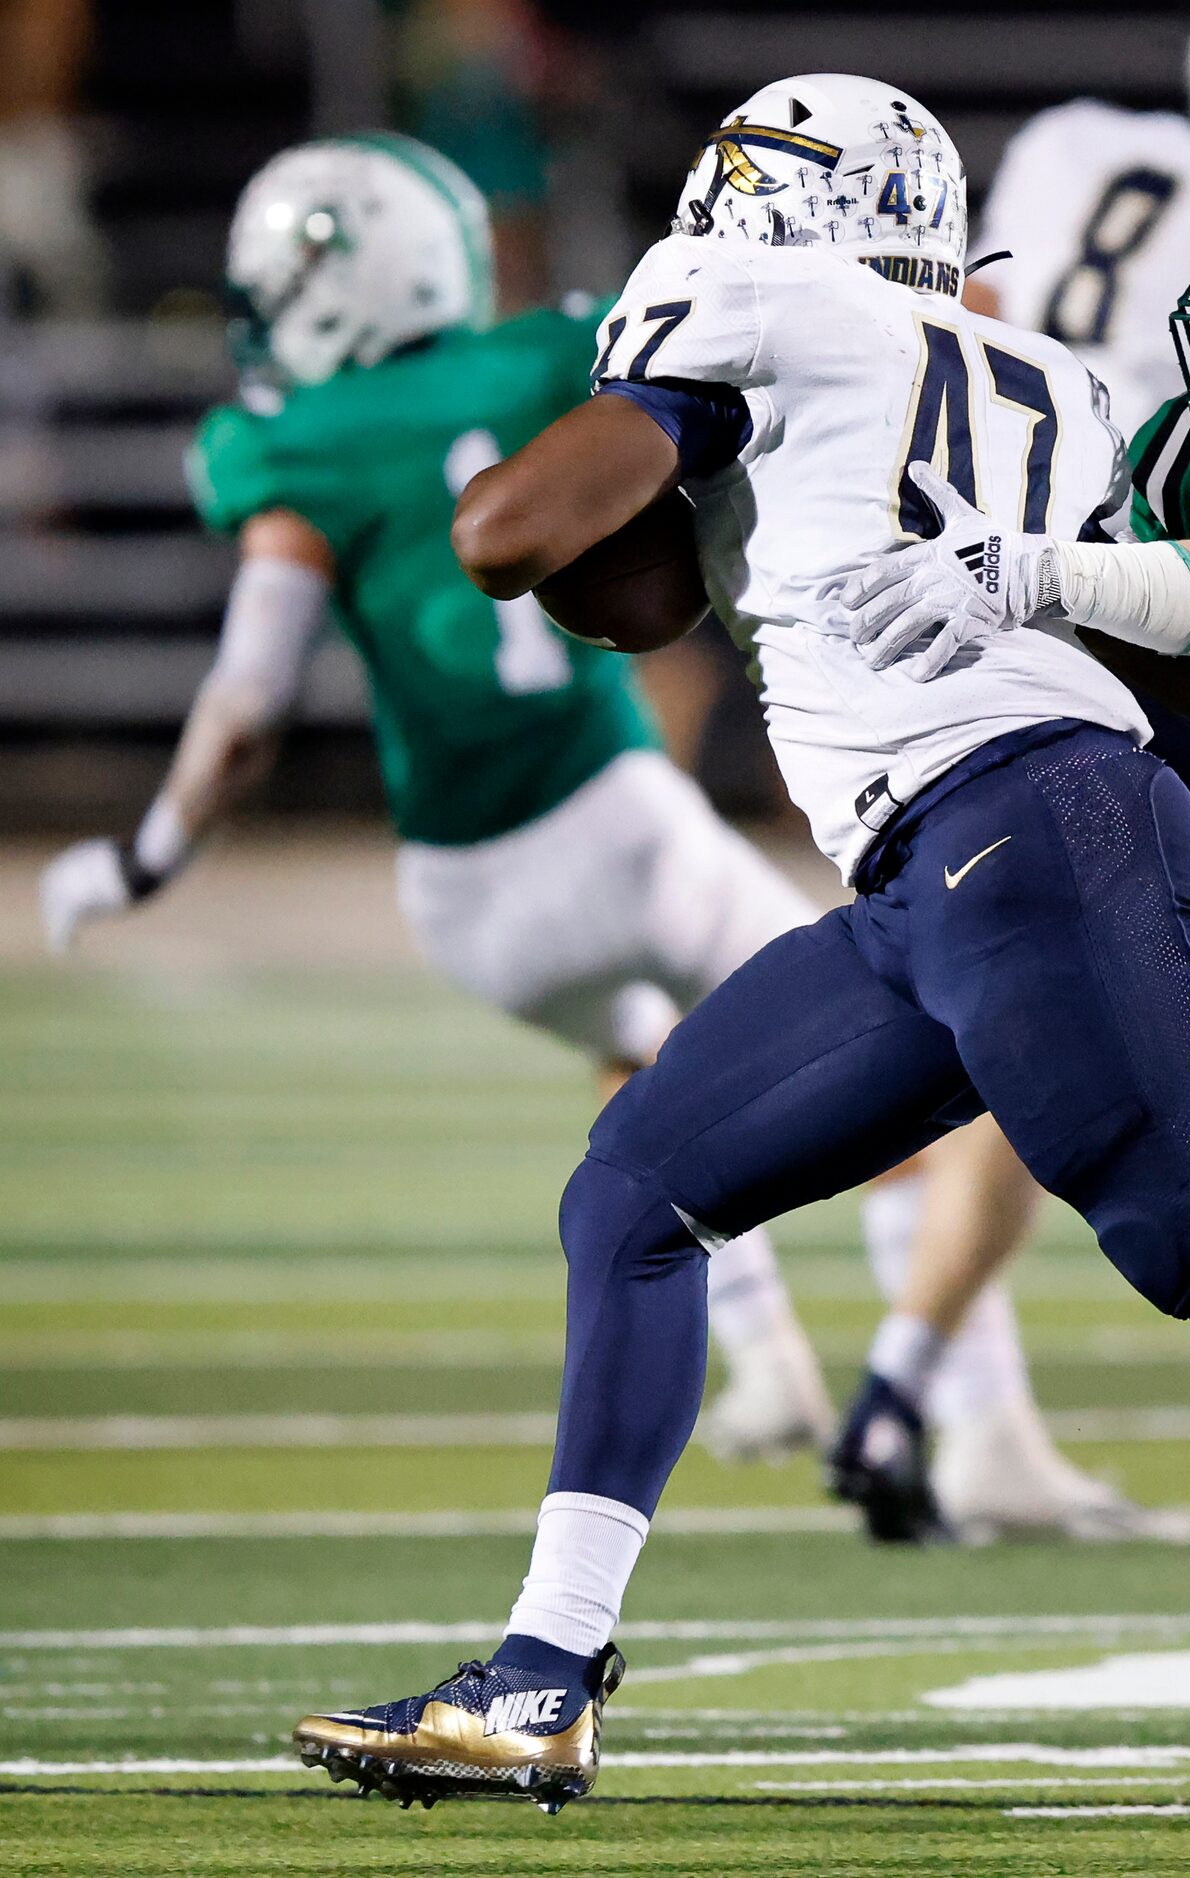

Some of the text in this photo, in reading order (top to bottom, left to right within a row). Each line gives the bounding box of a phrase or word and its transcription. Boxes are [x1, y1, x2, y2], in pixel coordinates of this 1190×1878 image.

[827, 196, 857, 206] Riell
[876, 169, 948, 229] 47
[1044, 163, 1180, 344] 8
[891, 312, 1063, 540] 47
[983, 535, 1002, 594] adidas
[483, 1688, 568, 1738] NIKE
